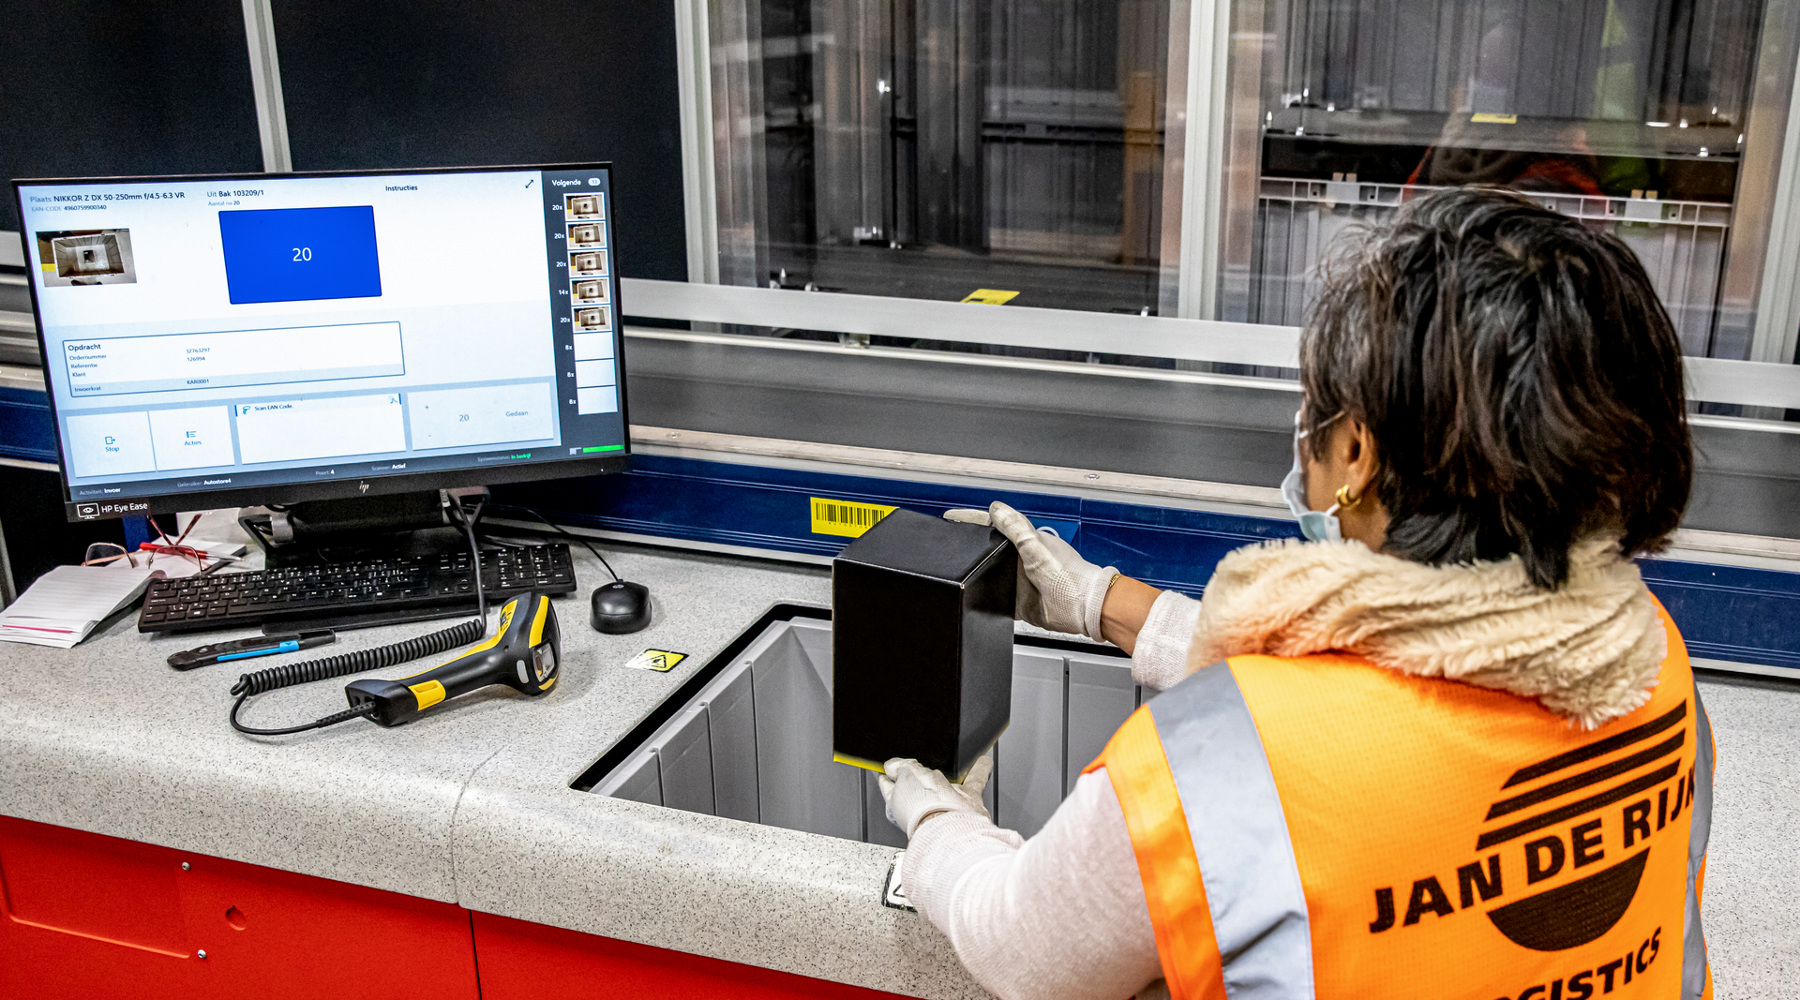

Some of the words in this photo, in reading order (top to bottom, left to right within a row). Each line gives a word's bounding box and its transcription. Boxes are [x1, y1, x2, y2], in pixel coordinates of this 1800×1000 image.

[552, 179, 581, 187] Volgende
[30, 195, 51, 203] Plaats
[53, 194, 83, 202] NIKKOR
[104, 193, 142, 201] 50-250mm
[143, 191, 173, 200] f/4.5-6.3
[175, 191, 185, 199] VR
[233, 189, 264, 197] 103209/1
[292, 247, 312, 262] 20
[68, 344, 101, 352] Opdracht
[459, 414, 469, 422] 20
[101, 505, 113, 513] HP
[114, 504, 129, 513] Eye
[130, 502, 148, 511] Ease
[1369, 853, 1503, 934] JAN
[1524, 817, 1605, 886] DE
